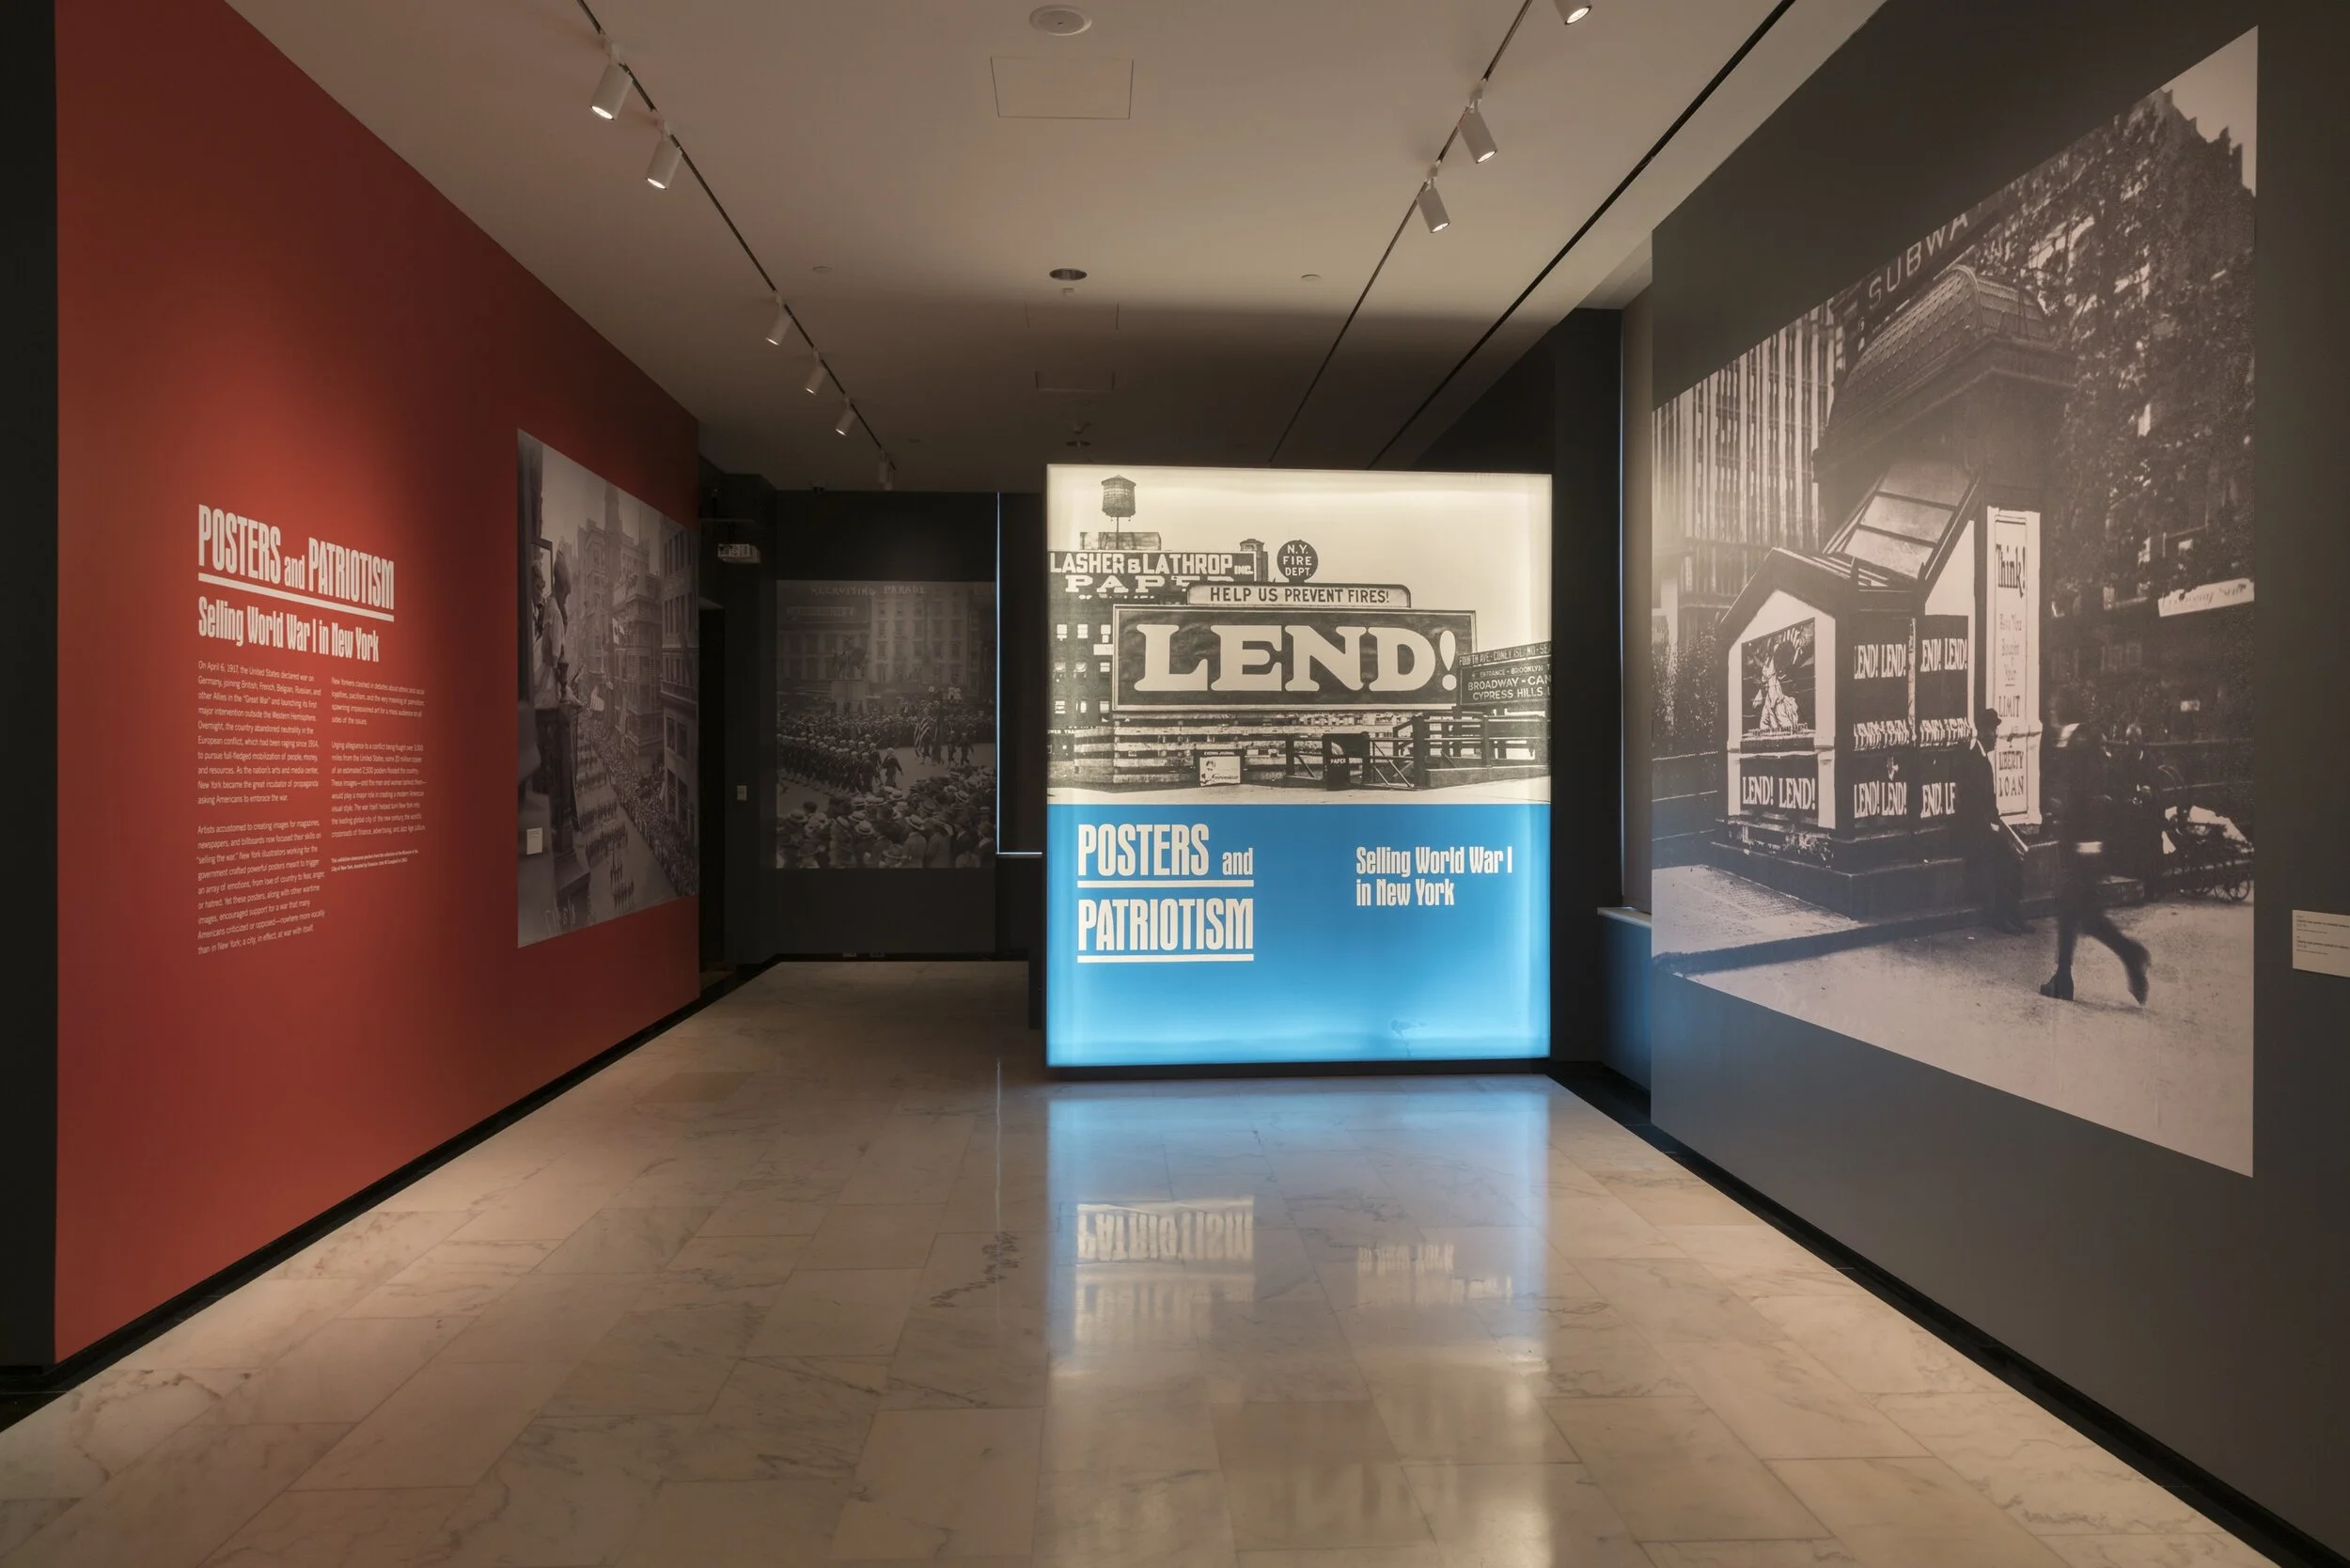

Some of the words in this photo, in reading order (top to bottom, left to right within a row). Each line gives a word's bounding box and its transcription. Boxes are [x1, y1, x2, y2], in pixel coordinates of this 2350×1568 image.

[1869, 203, 1982, 309] SUBWA
[198, 504, 281, 584] POSTERS
[284, 555, 305, 590] and
[308, 537, 395, 610] PATRIOTISM
[1050, 552, 1124, 573] LASHER
[1142, 553, 1233, 575] LATHROP
[1283, 556, 1312, 566] FIRE
[1287, 544, 1308, 554] N.Y.
[1065, 574, 1234, 593] PAPE
[1285, 567, 1311, 576] DEPT.
[1996, 543, 2026, 599] Think!
[1210, 587, 1252, 603] HELP
[1258, 588, 1278, 603] US
[1285, 588, 1343, 603] PREVENT
[1348, 589, 1389, 604] FIRES!
[198, 596, 243, 647] Selling
[247, 605, 284, 649] World
[286, 613, 310, 652] War
[312, 619, 316, 653] I
[319, 619, 329, 656] in
[332, 621, 353, 659] New
[355, 626, 379, 663] York
[1134, 623, 1457, 692] LEND!
[1511, 665, 1543, 674] BROOKLYN
[1854, 644, 1878, 680] LEND!
[1881, 644, 1906, 678] LEND!
[1944, 637, 1967, 670] LEND!
[1467, 677, 1519, 691] BROADWAY
[1472, 689, 1513, 700] CYPRESS
[1517, 686, 1543, 698] HILLS
[1998, 750, 2024, 771] LIBERTY
[1742, 776, 1774, 806] LEND!
[1778, 777, 1815, 810] LEND!
[1854, 780, 1879, 819] LEND!
[1881, 781, 1906, 816] LEND!
[1077, 823, 1210, 877] POSTERS
[1222, 848, 1253, 875] and
[1355, 846, 1410, 878] Selling
[1416, 846, 1465, 874] World
[1469, 847, 1503, 874] War
[1507, 846, 1512, 873] I
[1355, 879, 1371, 906] in
[1376, 879, 1410, 906] New
[1416, 879, 1454, 906] York
[1077, 898, 1254, 950] PATRIOTISM
